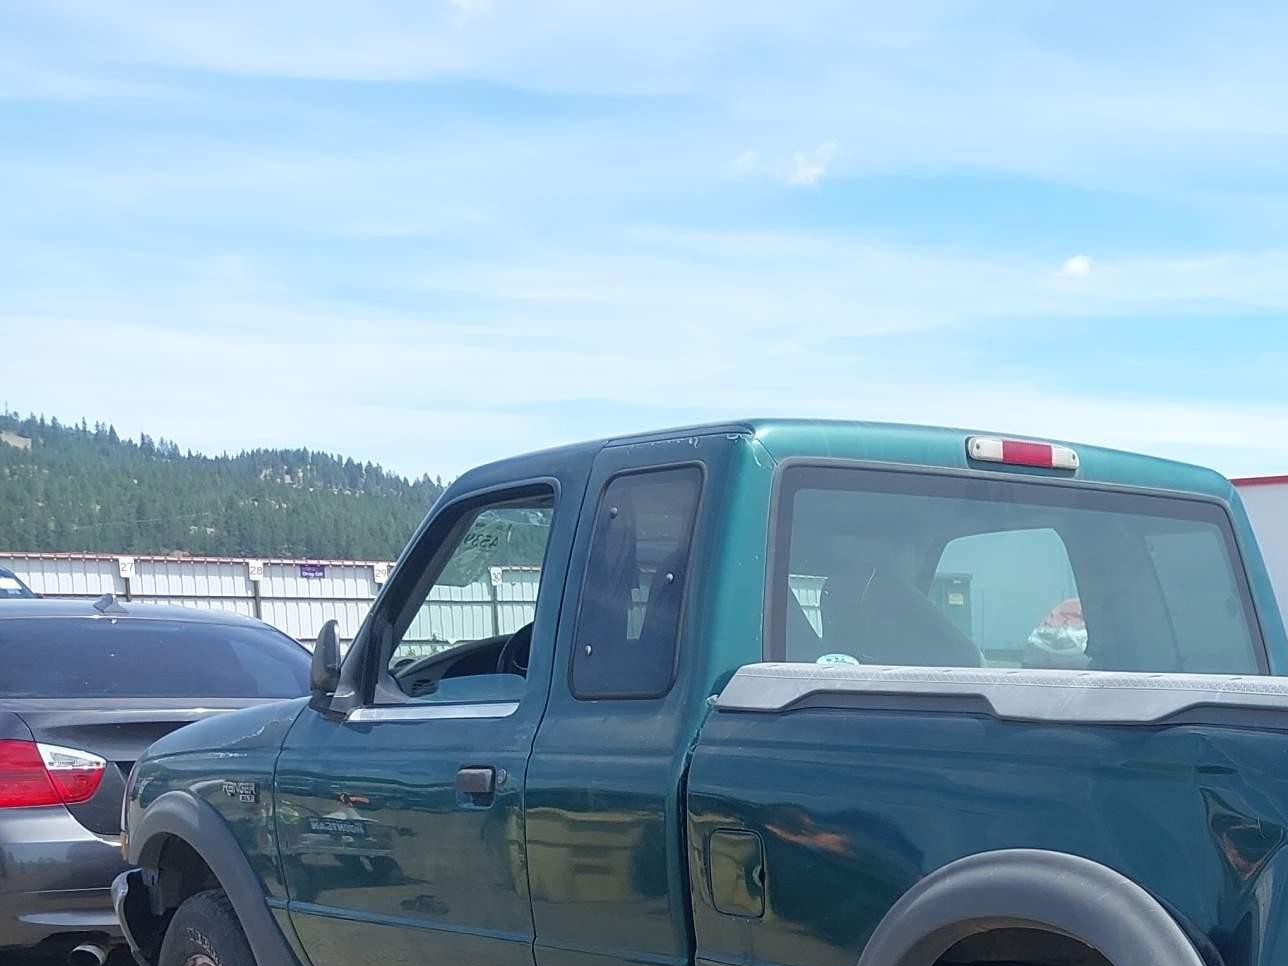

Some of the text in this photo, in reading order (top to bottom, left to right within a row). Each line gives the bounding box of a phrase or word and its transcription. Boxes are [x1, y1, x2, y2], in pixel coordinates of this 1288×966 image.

[120, 562, 134, 572] 27
[249, 566, 263, 576] 28
[375, 569, 387, 578] 29
